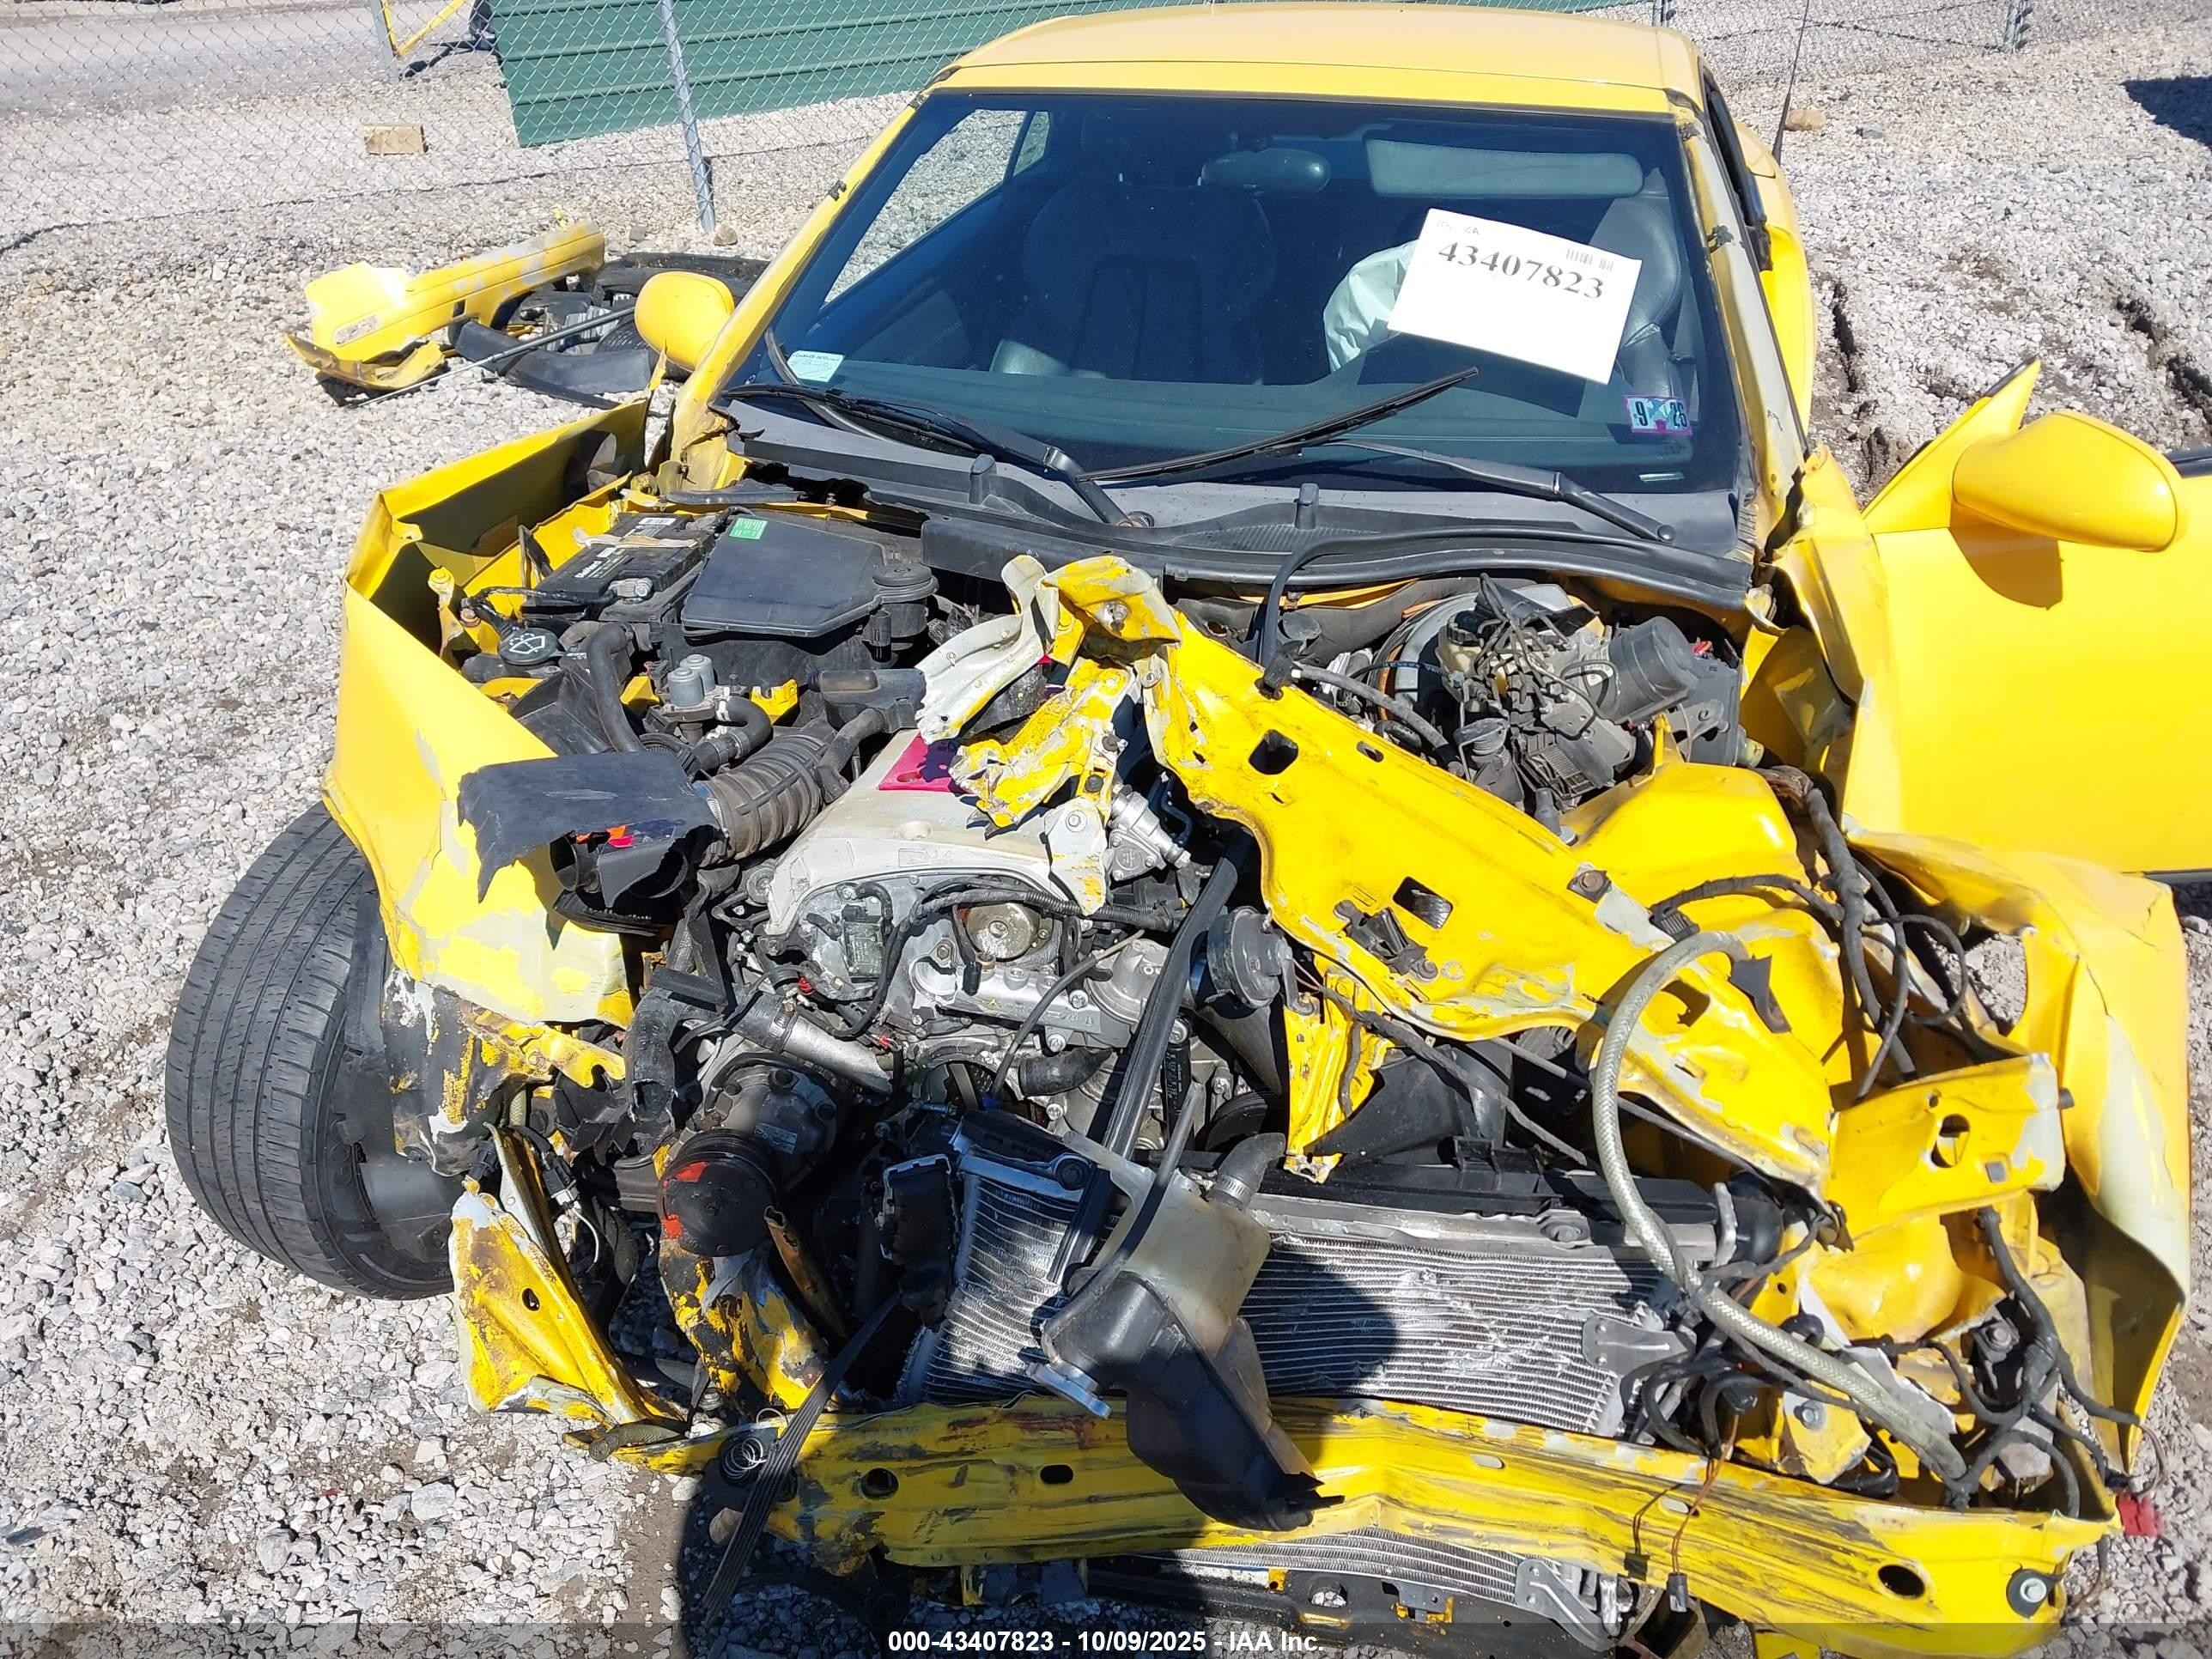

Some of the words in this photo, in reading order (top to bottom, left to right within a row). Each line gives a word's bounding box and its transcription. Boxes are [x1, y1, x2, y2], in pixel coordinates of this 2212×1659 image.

[1438, 241, 1604, 299] 43407823
[1635, 400, 1649, 427] 9
[1669, 401, 1688, 428] 26
